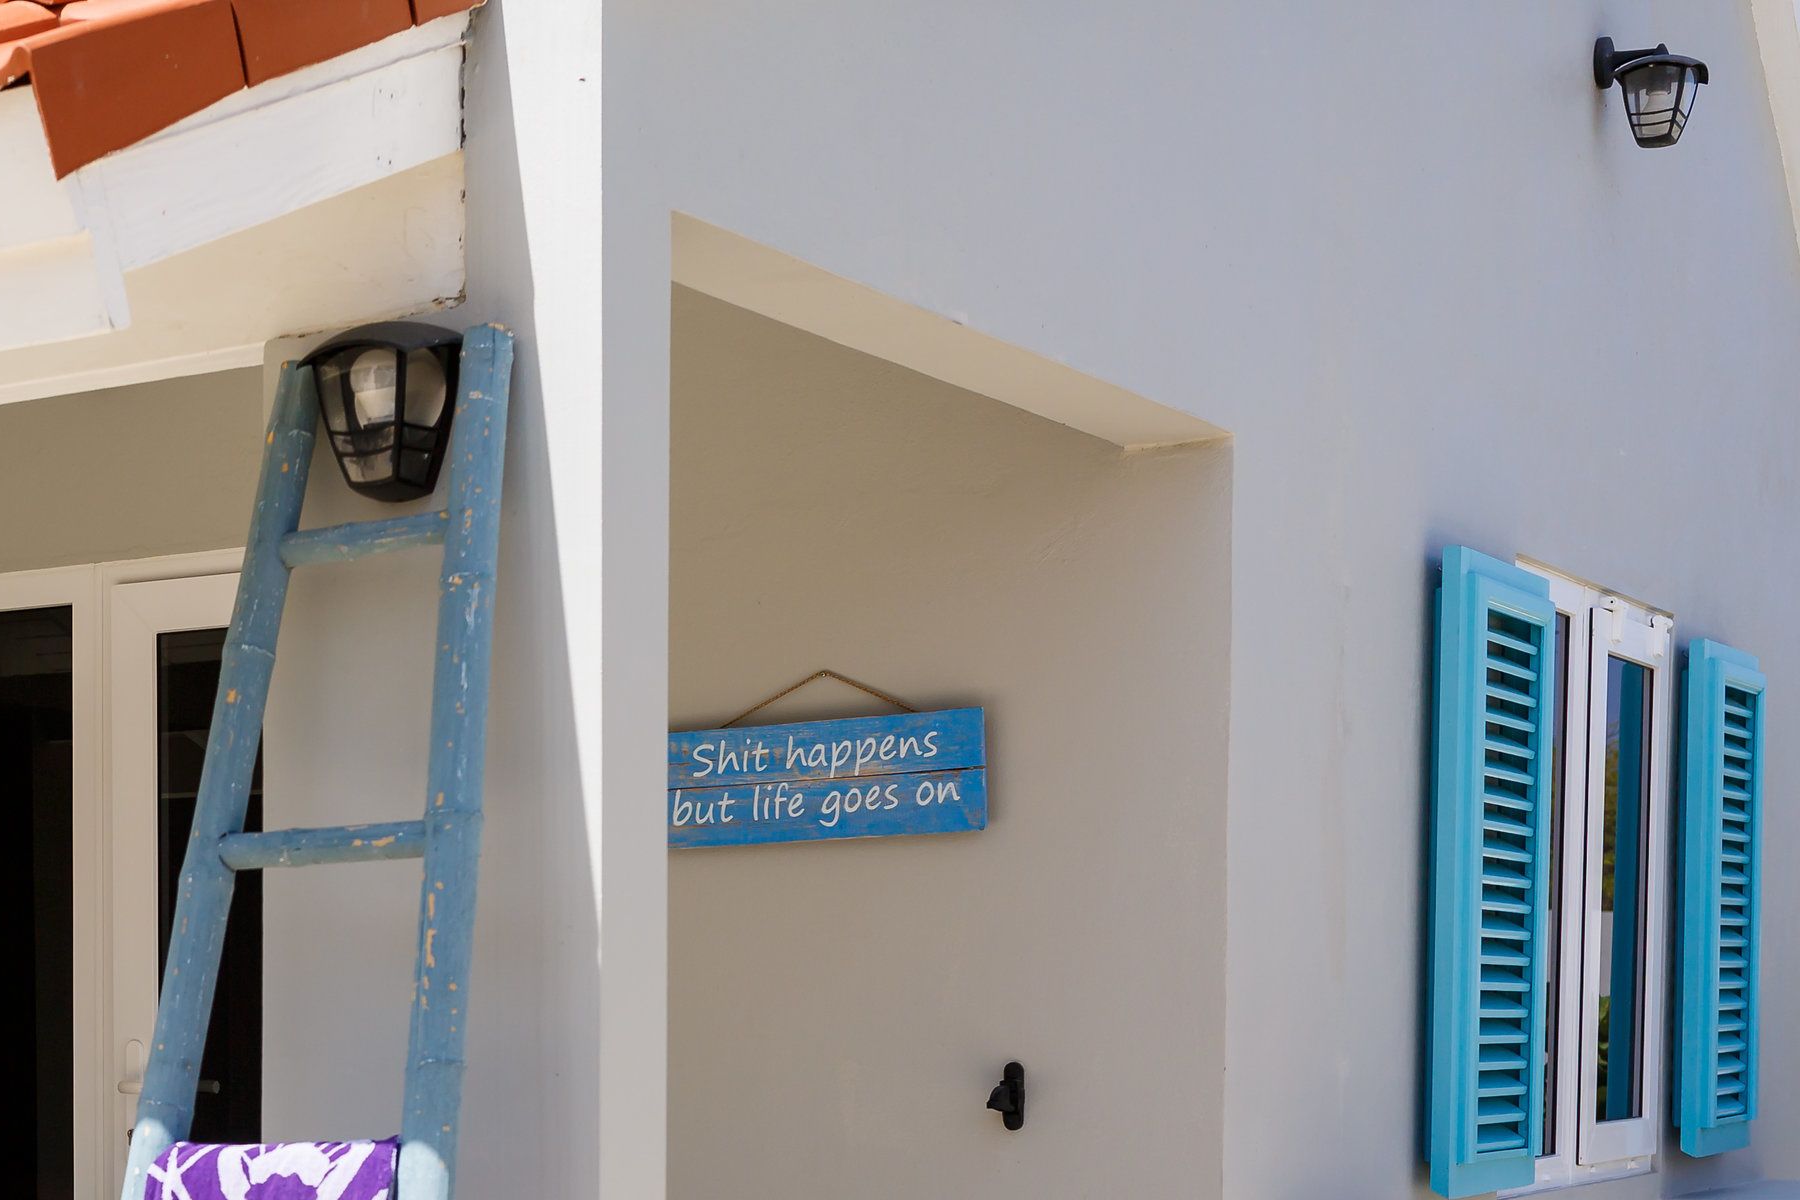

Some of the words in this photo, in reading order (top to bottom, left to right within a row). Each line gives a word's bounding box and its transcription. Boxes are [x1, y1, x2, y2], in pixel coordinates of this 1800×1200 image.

[692, 738, 769, 778] Shit
[785, 731, 938, 779] happens
[672, 788, 736, 827] but
[753, 782, 805, 821] life
[819, 783, 900, 828] goes
[915, 780, 961, 807] on
